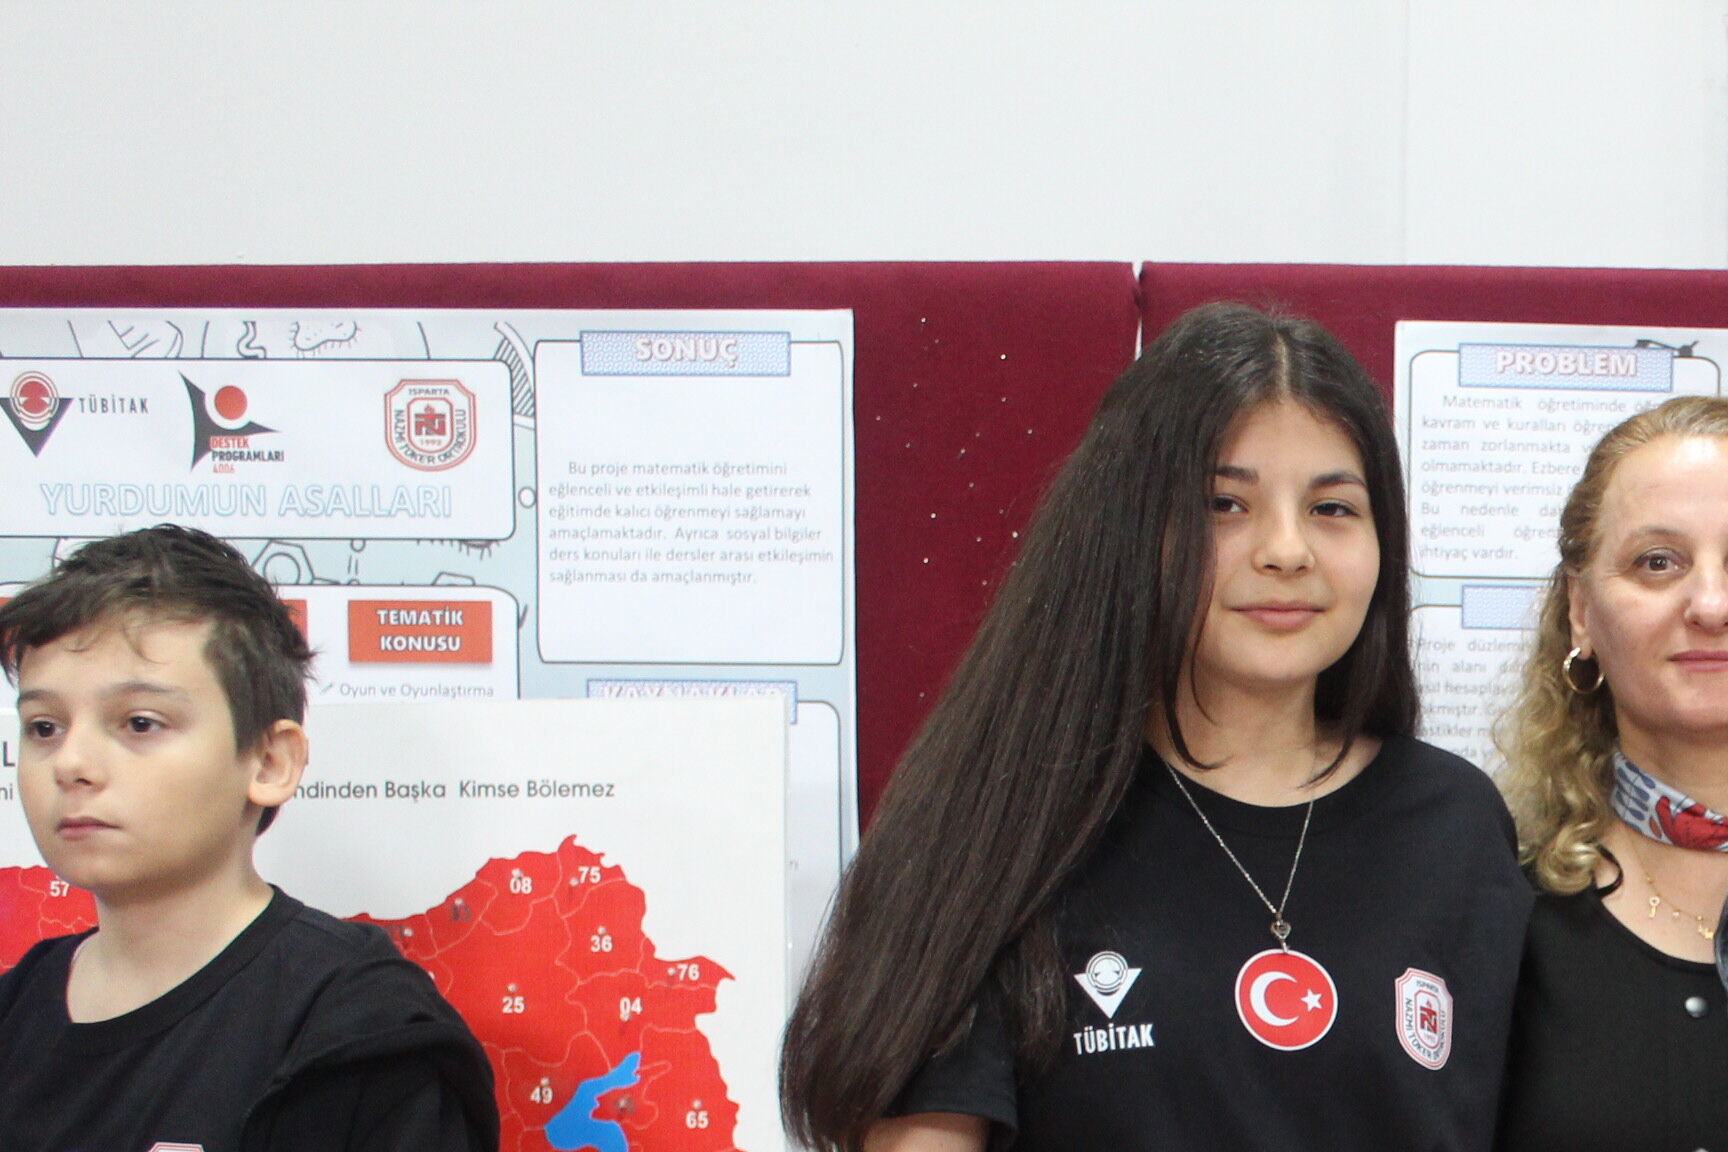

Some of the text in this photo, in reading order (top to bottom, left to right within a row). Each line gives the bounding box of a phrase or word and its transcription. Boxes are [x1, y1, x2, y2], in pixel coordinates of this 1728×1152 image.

[635, 338, 738, 368] SONUÇ
[1496, 352, 1638, 377] PROBLEM
[79, 394, 149, 414] TÜBİTAK
[1443, 396, 1626, 414] Matematik öğretiminde
[1422, 418, 1475, 430] kavram
[212, 437, 249, 448] DESTEK
[1422, 440, 1570, 454] zaman zorlanmakta
[212, 451, 284, 461] PROGRAMLARI
[569, 462, 787, 477] Bu proje matematik öğretimini
[1532, 462, 1580, 474] Ezbere
[550, 484, 811, 498] eğlenceli ve etkileşimli hale getirerek
[1421, 483, 1562, 496] öğrenmeyi verimsiz
[40, 482, 452, 518] YURDUMUN ASALLARI
[550, 506, 805, 520] eğitimde kalıcı öğrenmeyi sağlamayı
[1422, 503, 1518, 516] Bu nedenle
[675, 528, 718, 540] Ayrıca
[727, 528, 770, 540] sosyal
[774, 528, 821, 541] bilgiler
[1421, 525, 1484, 538] eğlenceli
[550, 550, 833, 562] ders konuları ile dersler arası etkileşimin
[550, 571, 626, 584] sağlanması
[630, 571, 647, 582] da
[377, 606, 463, 626] TEMATİK
[381, 635, 461, 652] KONUSU
[340, 682, 494, 699] Oyun ve Oyunlaştırma
[295, 780, 615, 801] ndinden Başka Kimse Bölemez
[578, 867, 601, 883] 75
[50, 881, 69, 897] 57
[510, 878, 532, 894] 08
[590, 936, 612, 952] 36
[677, 964, 699, 980] 76
[502, 997, 525, 1013] 25
[620, 997, 642, 1014] 04
[1073, 1023, 1154, 1055] TÜBİTAK
[530, 1087, 553, 1104] 49
[686, 1112, 708, 1128] 65
